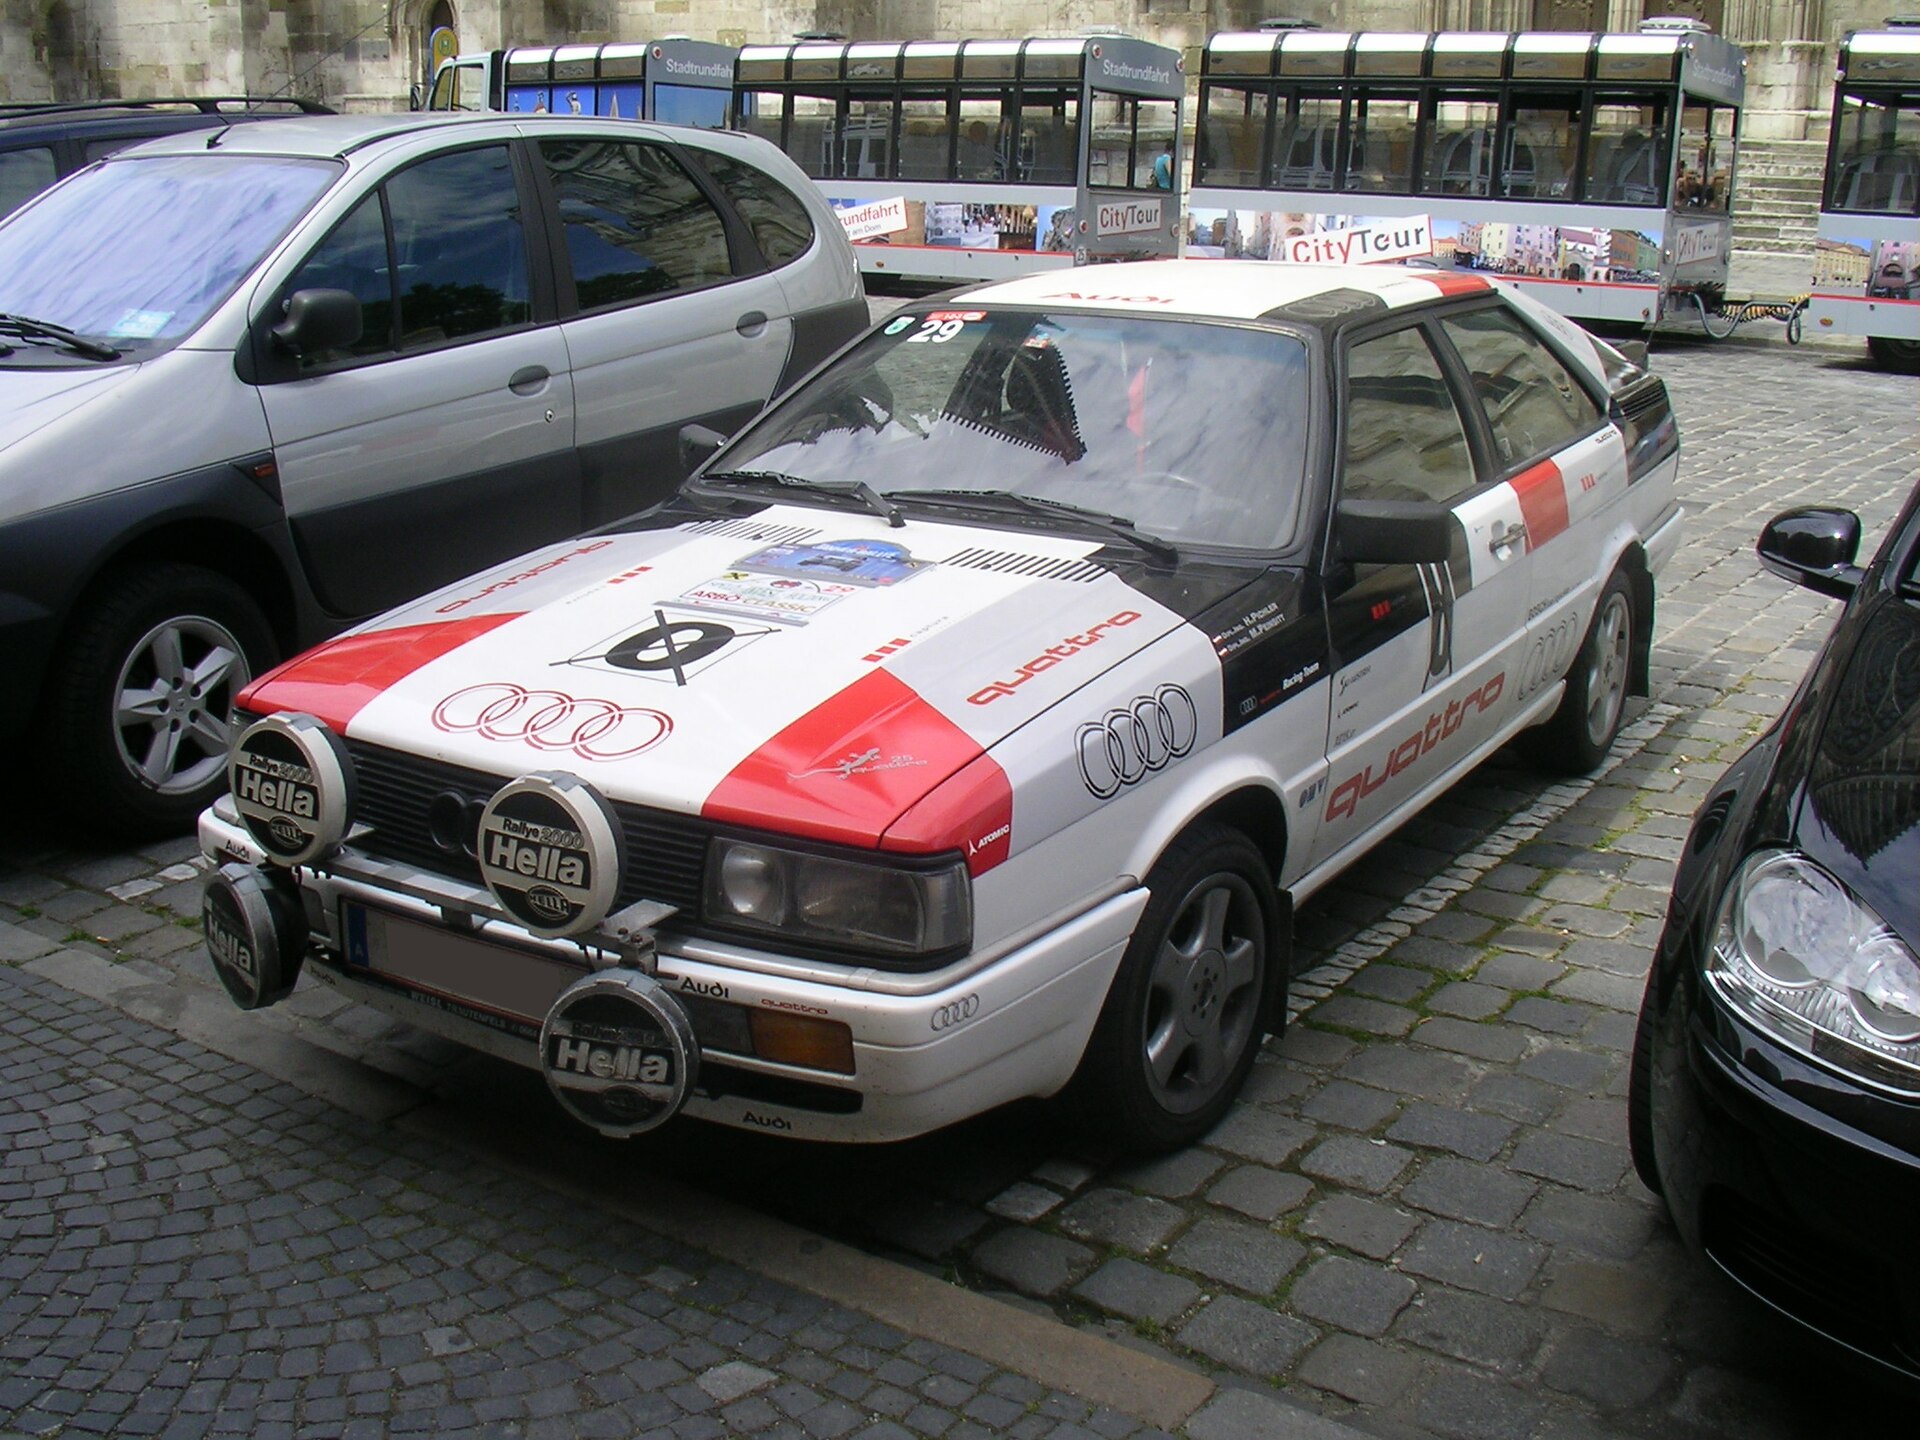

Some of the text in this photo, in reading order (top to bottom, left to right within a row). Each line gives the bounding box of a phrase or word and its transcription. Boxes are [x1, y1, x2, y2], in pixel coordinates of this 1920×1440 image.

[1102, 58, 1170, 84] Stadtrundfahrt
[864, 224, 881, 234] Dom
[1100, 205, 1160, 231] CityTour
[1292, 226, 1425, 265] CityTour
[1038, 291, 1176, 305] Audi
[906, 319, 965, 344] 29
[691, 588, 743, 603] ARBÖ
[966, 610, 1142, 706] quattro
[1325, 671, 1505, 823] quattro
[250, 754, 279, 773] Rallye
[240, 768, 315, 818] Hella
[502, 817, 585, 850] Rallye 2000
[977, 823, 1011, 850] ATOMIC
[225, 839, 251, 860] Audi
[490, 834, 585, 886] Hella
[680, 976, 729, 998] Audi
[760, 997, 829, 1016] quattro
[555, 1037, 669, 1084] Hella
[741, 1110, 792, 1131] Audi
